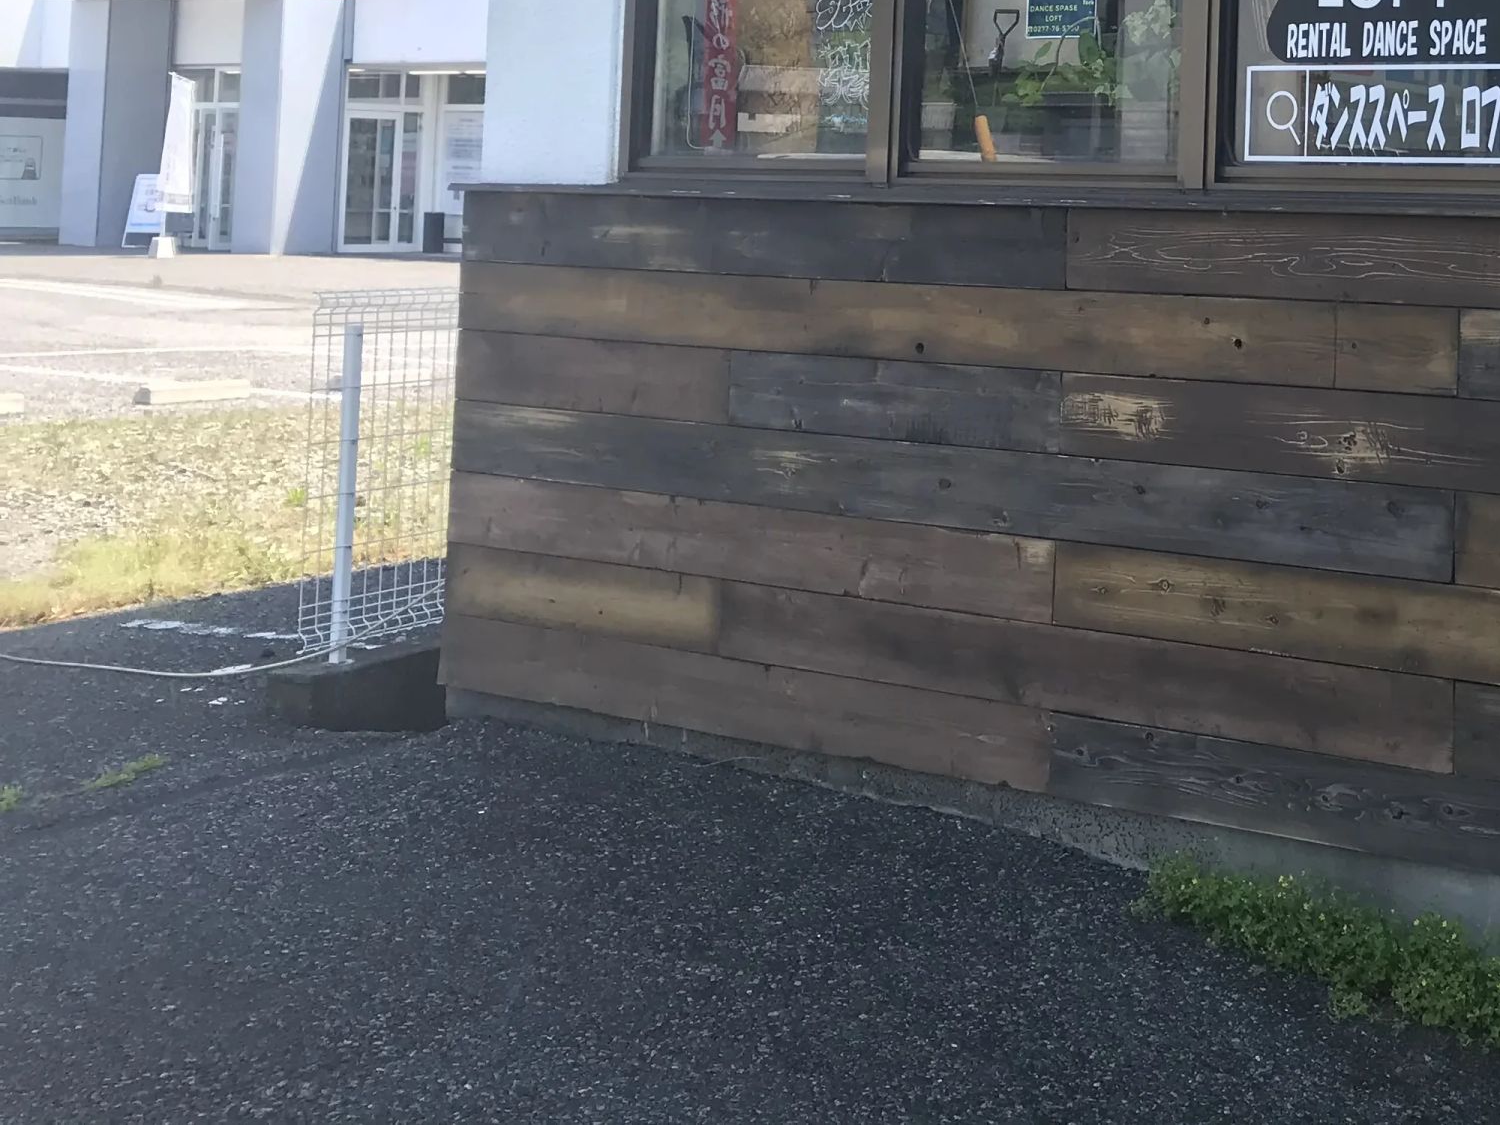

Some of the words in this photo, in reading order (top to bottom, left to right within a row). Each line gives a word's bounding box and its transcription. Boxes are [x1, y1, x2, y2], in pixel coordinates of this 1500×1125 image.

[1030, 4, 1054, 13] DANCE
[1045, 14, 1063, 23] LOFT
[1286, 21, 1351, 59] RENTAL
[1361, 19, 1419, 57] DANCE
[1429, 18, 1487, 56] SPACE
[1310, 81, 1446, 151] ダンススペース
